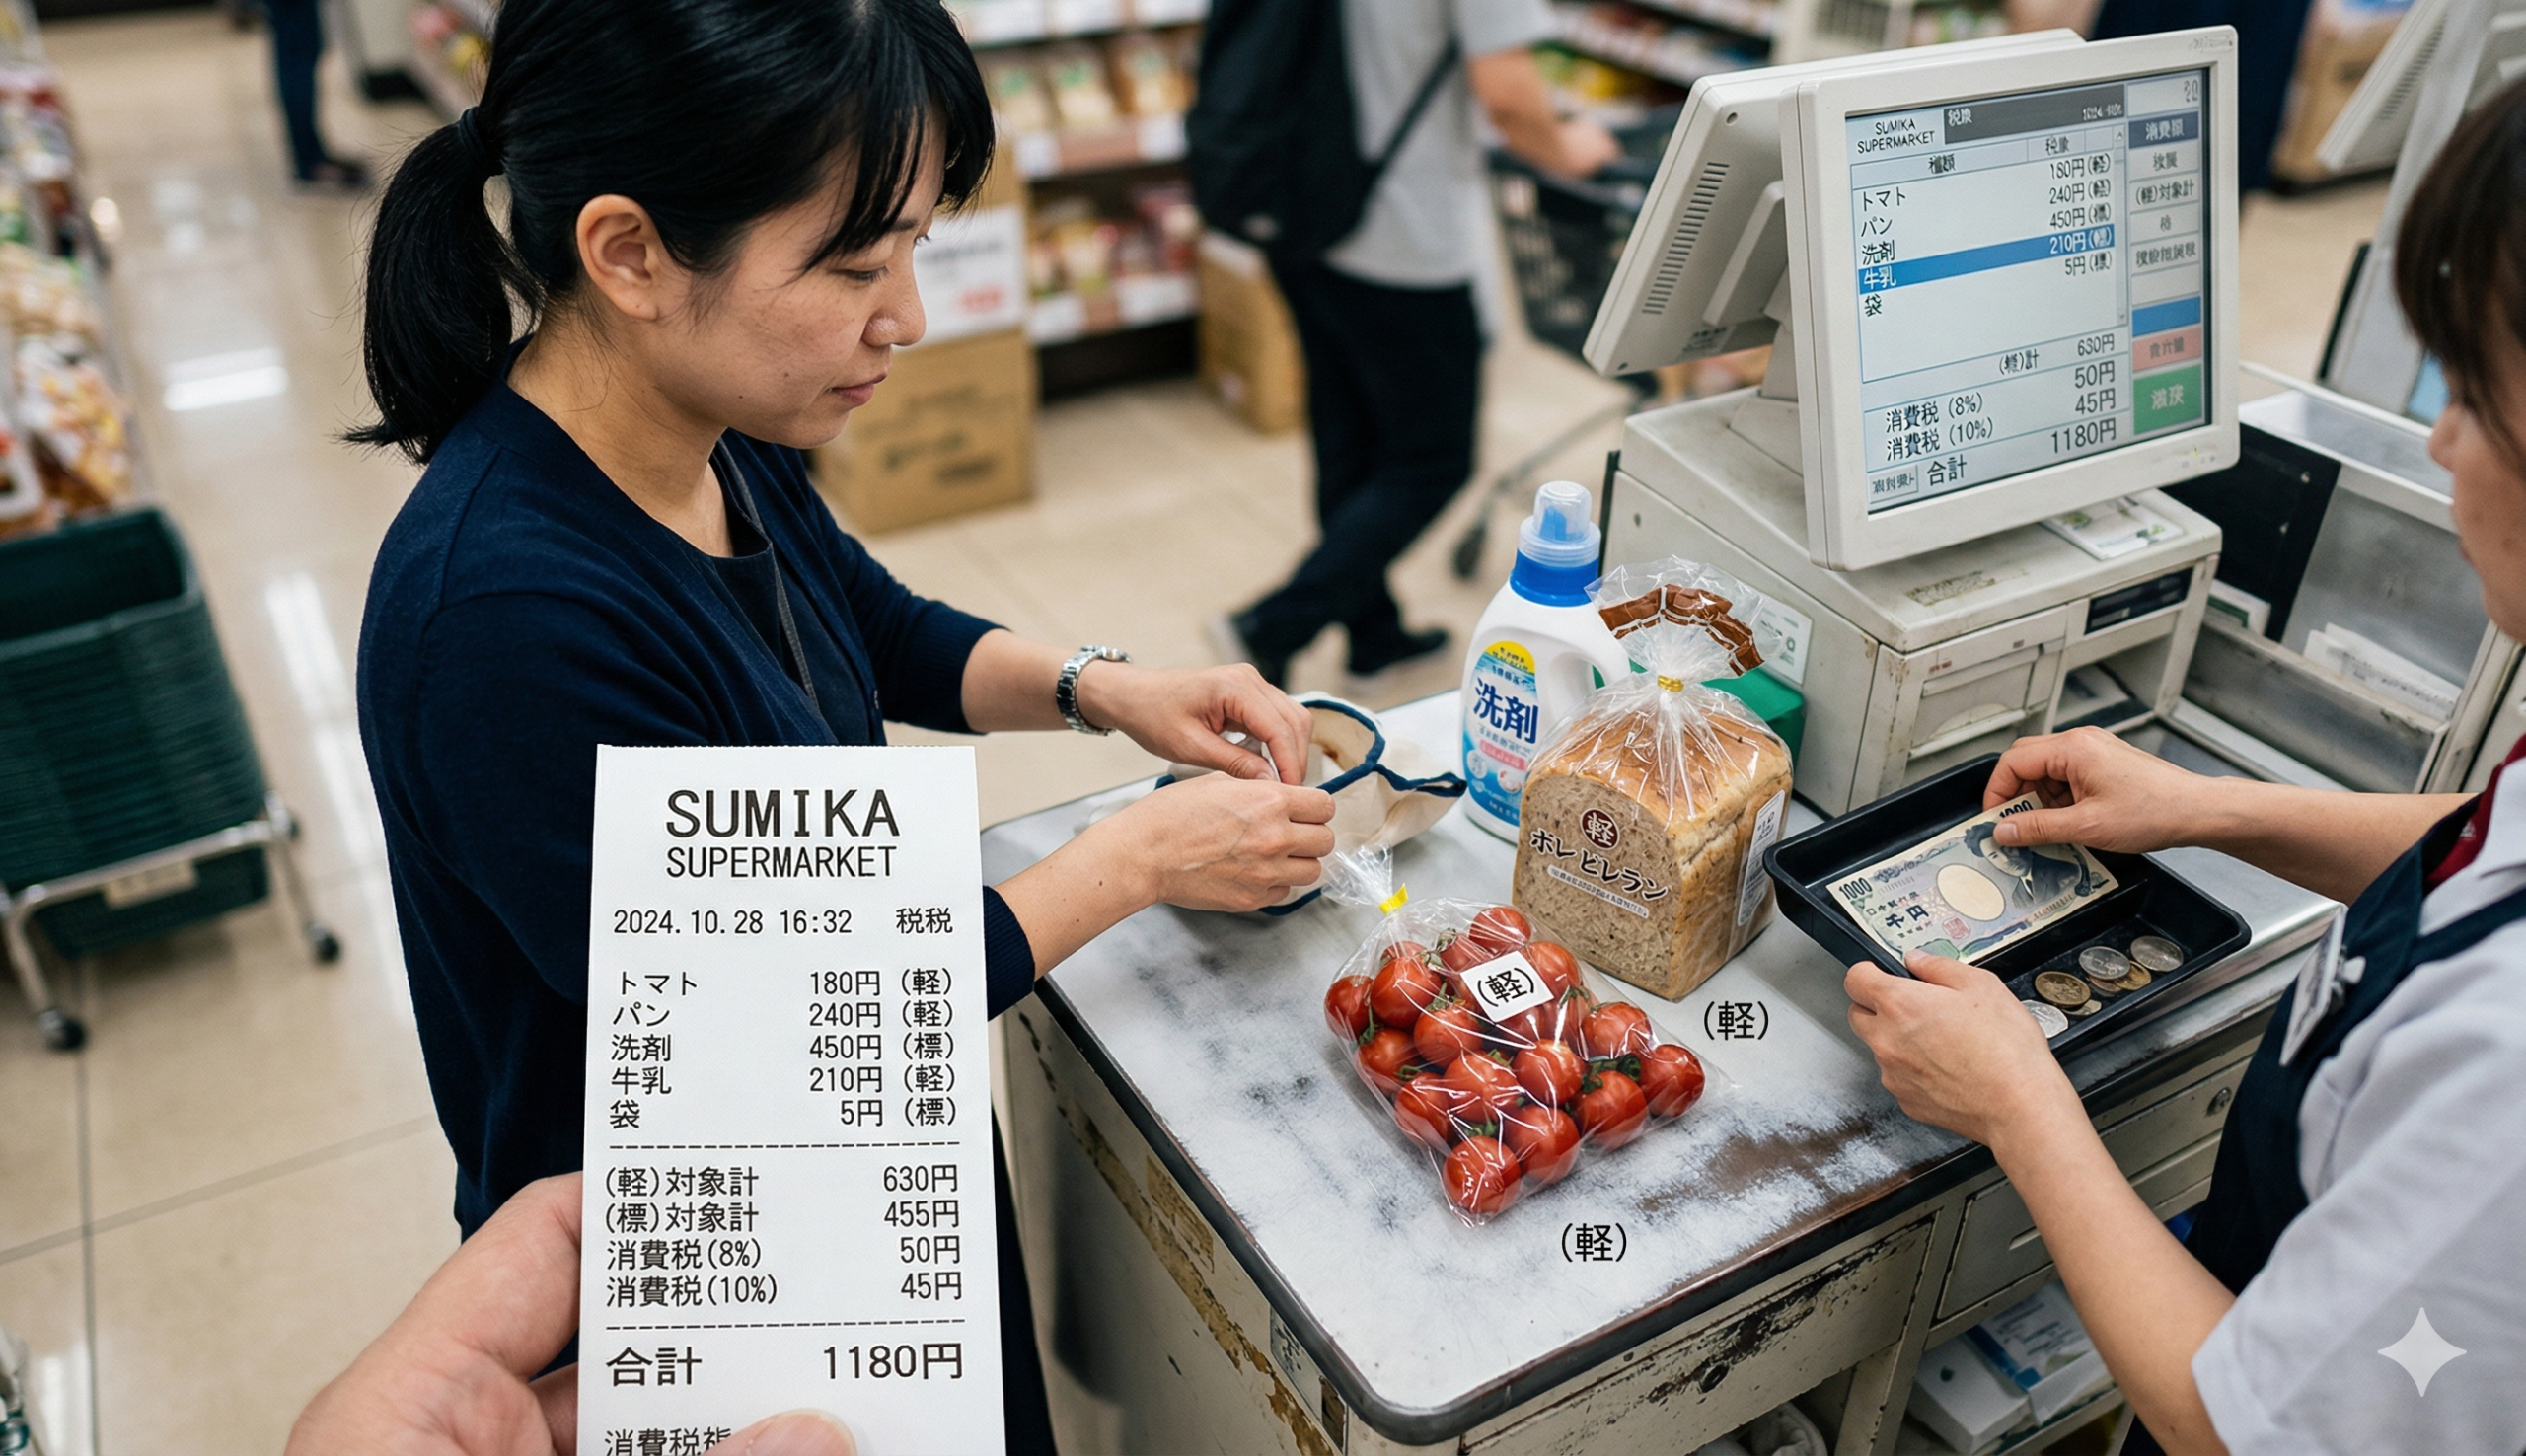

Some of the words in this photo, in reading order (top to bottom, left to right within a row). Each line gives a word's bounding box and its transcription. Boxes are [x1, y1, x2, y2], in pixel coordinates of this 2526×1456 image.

[1857, 130, 1935, 154] SUPERMARKET
[1875, 117, 1916, 136] SUMIKA
[1860, 216, 1893, 238] パン
[2049, 182, 2085, 205] 240円
[1862, 186, 1906, 212] トマト
[1861, 239, 1895, 265] 洗剤
[2049, 207, 2086, 230] 450円
[1863, 265, 1897, 291] 牛乳
[2049, 231, 2087, 255] 210円
[2065, 255, 2086, 277] 5円
[1886, 400, 1939, 433] 消費税
[1948, 392, 1983, 419] (8%)
[2075, 360, 2115, 389] 50円
[1887, 427, 1940, 461] 消費税
[1949, 416, 1993, 446] (10%)
[2075, 387, 2116, 415] 45円
[1926, 454, 1967, 486] 合計
[2051, 417, 2117, 454] 1180円
[1473, 677, 1538, 744] 洗剤
[666, 789, 900, 838] SUMIKA
[1586, 812, 1614, 846] 軽
[666, 845, 897, 878] SUPERMARKET
[1839, 877, 1873, 900] 1000
[614, 909, 764, 934] 2024.10.28
[780, 909, 853, 934] 16:32
[896, 907, 953, 935] 税税
[1885, 905, 1929, 929] 千円
[621, 971, 698, 996] トマト
[810, 970, 881, 996] 180円
[901, 968, 953, 996] (軽)
[1477, 967, 1535, 1008] (軽)
[613, 1001, 670, 1027] パン
[809, 1001, 881, 1029] 240円
[902, 1000, 954, 1028] (軽)
[611, 1033, 671, 1062] 洗剤
[809, 1034, 882, 1061] 450円
[903, 1032, 955, 1060] (標)
[611, 1065, 672, 1095] 牛乳
[809, 1066, 883, 1094] 210円
[904, 1064, 956, 1093] (軽)
[610, 1099, 640, 1129] 袋
[841, 1099, 884, 1128] 5円
[904, 1097, 957, 1127] (標)
[606, 1166, 760, 1199] (軽)対象計
[883, 1164, 958, 1193] 630円
[605, 1201, 760, 1234] (標)対象計
[883, 1199, 959, 1228] 455円
[607, 1237, 762, 1271] 消費税(8%)
[900, 1235, 961, 1265] 50円
[606, 1274, 778, 1308] 消費税(10%)
[900, 1271, 962, 1301] 45円
[605, 1346, 703, 1387] 合計
[823, 1343, 963, 1380] 1180円
